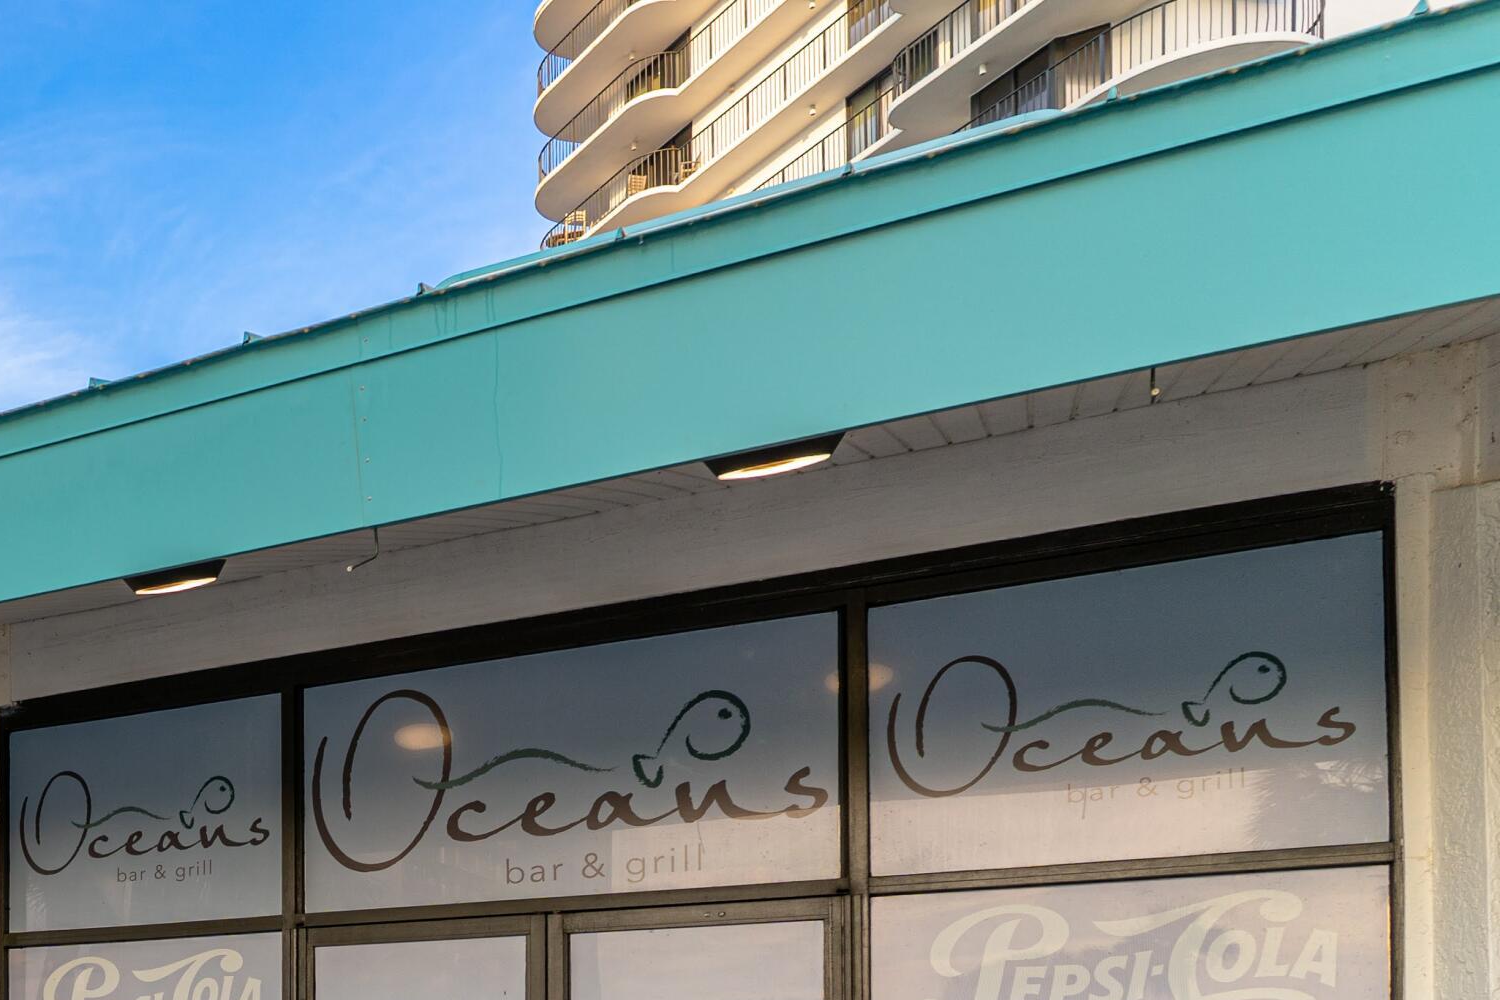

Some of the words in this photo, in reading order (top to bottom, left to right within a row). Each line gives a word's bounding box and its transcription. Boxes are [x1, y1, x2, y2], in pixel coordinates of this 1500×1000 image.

[887, 652, 1357, 798] Oceans
[311, 688, 831, 873] Oceans
[1067, 783, 1120, 803] bar
[1136, 776, 1159, 798] &
[1176, 766, 1246, 800] grill
[19, 770, 271, 876] Oceans
[116, 867, 147, 883] bar
[154, 864, 167, 880] &
[175, 859, 213, 882] grill
[505, 857, 564, 885] bar
[581, 852, 606, 880] &
[625, 843, 703, 884] grill
